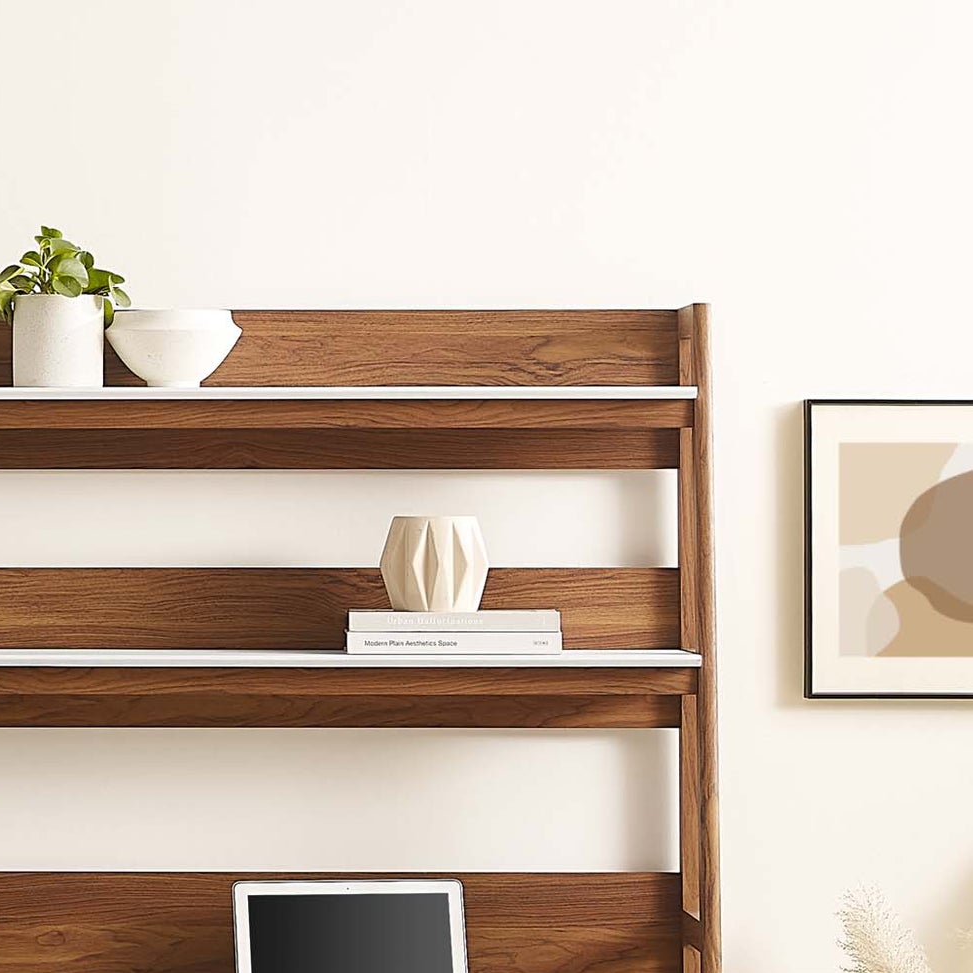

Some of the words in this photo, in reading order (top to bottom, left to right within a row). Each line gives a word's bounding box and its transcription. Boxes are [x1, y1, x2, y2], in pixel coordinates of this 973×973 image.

[364, 639, 388, 647] Modern
[389, 639, 404, 647] Plain
[405, 639, 437, 647] Aesthetics
[438, 639, 458, 648] Space
